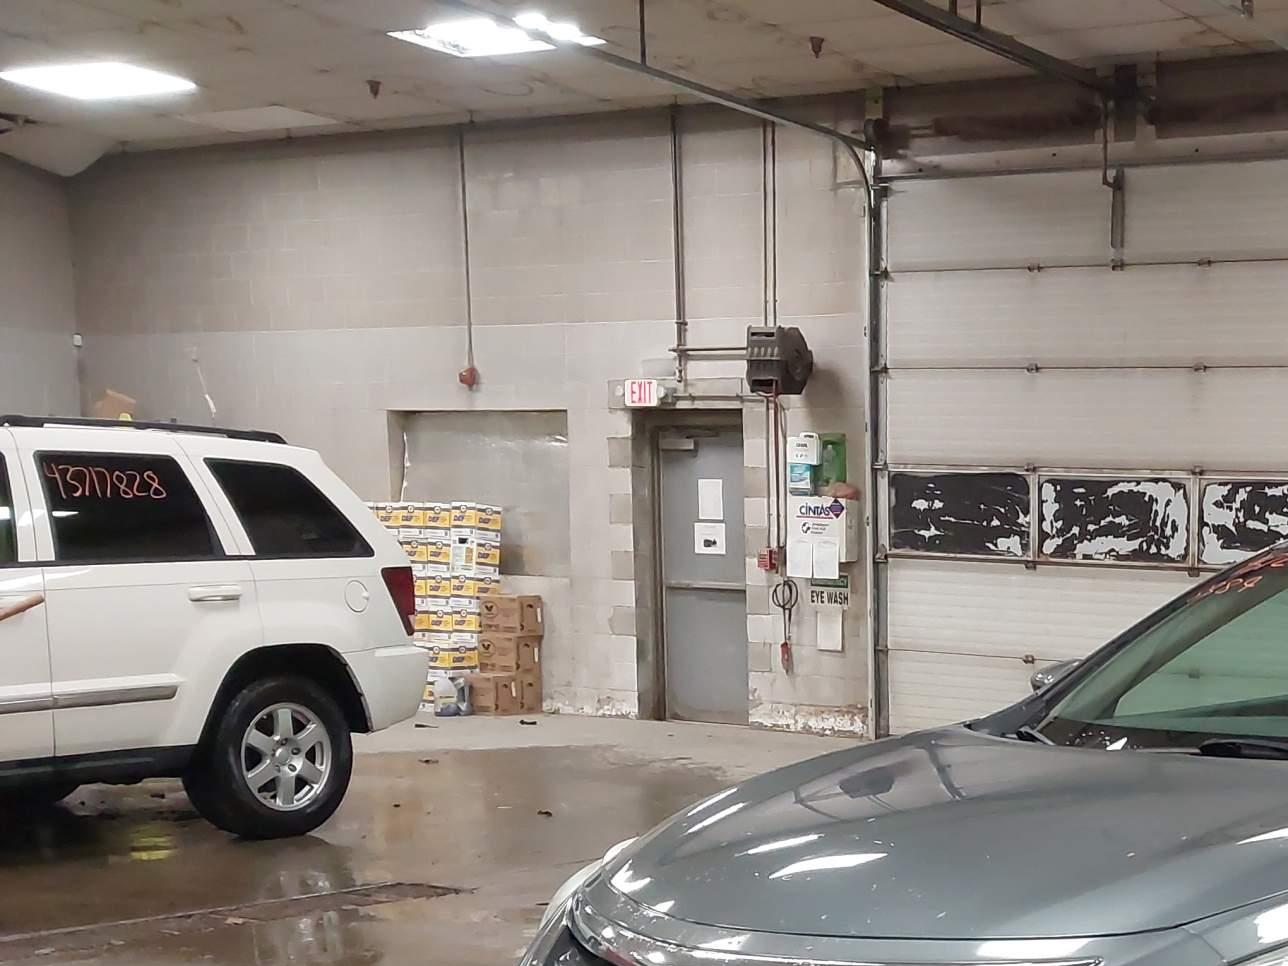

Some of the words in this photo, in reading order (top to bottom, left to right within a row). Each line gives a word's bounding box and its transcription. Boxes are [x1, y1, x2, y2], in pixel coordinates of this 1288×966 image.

[631, 381, 652, 404] EXIT
[42, 461, 166, 499] 43717828
[810, 590, 825, 604] EYE
[826, 591, 849, 605] WASH
